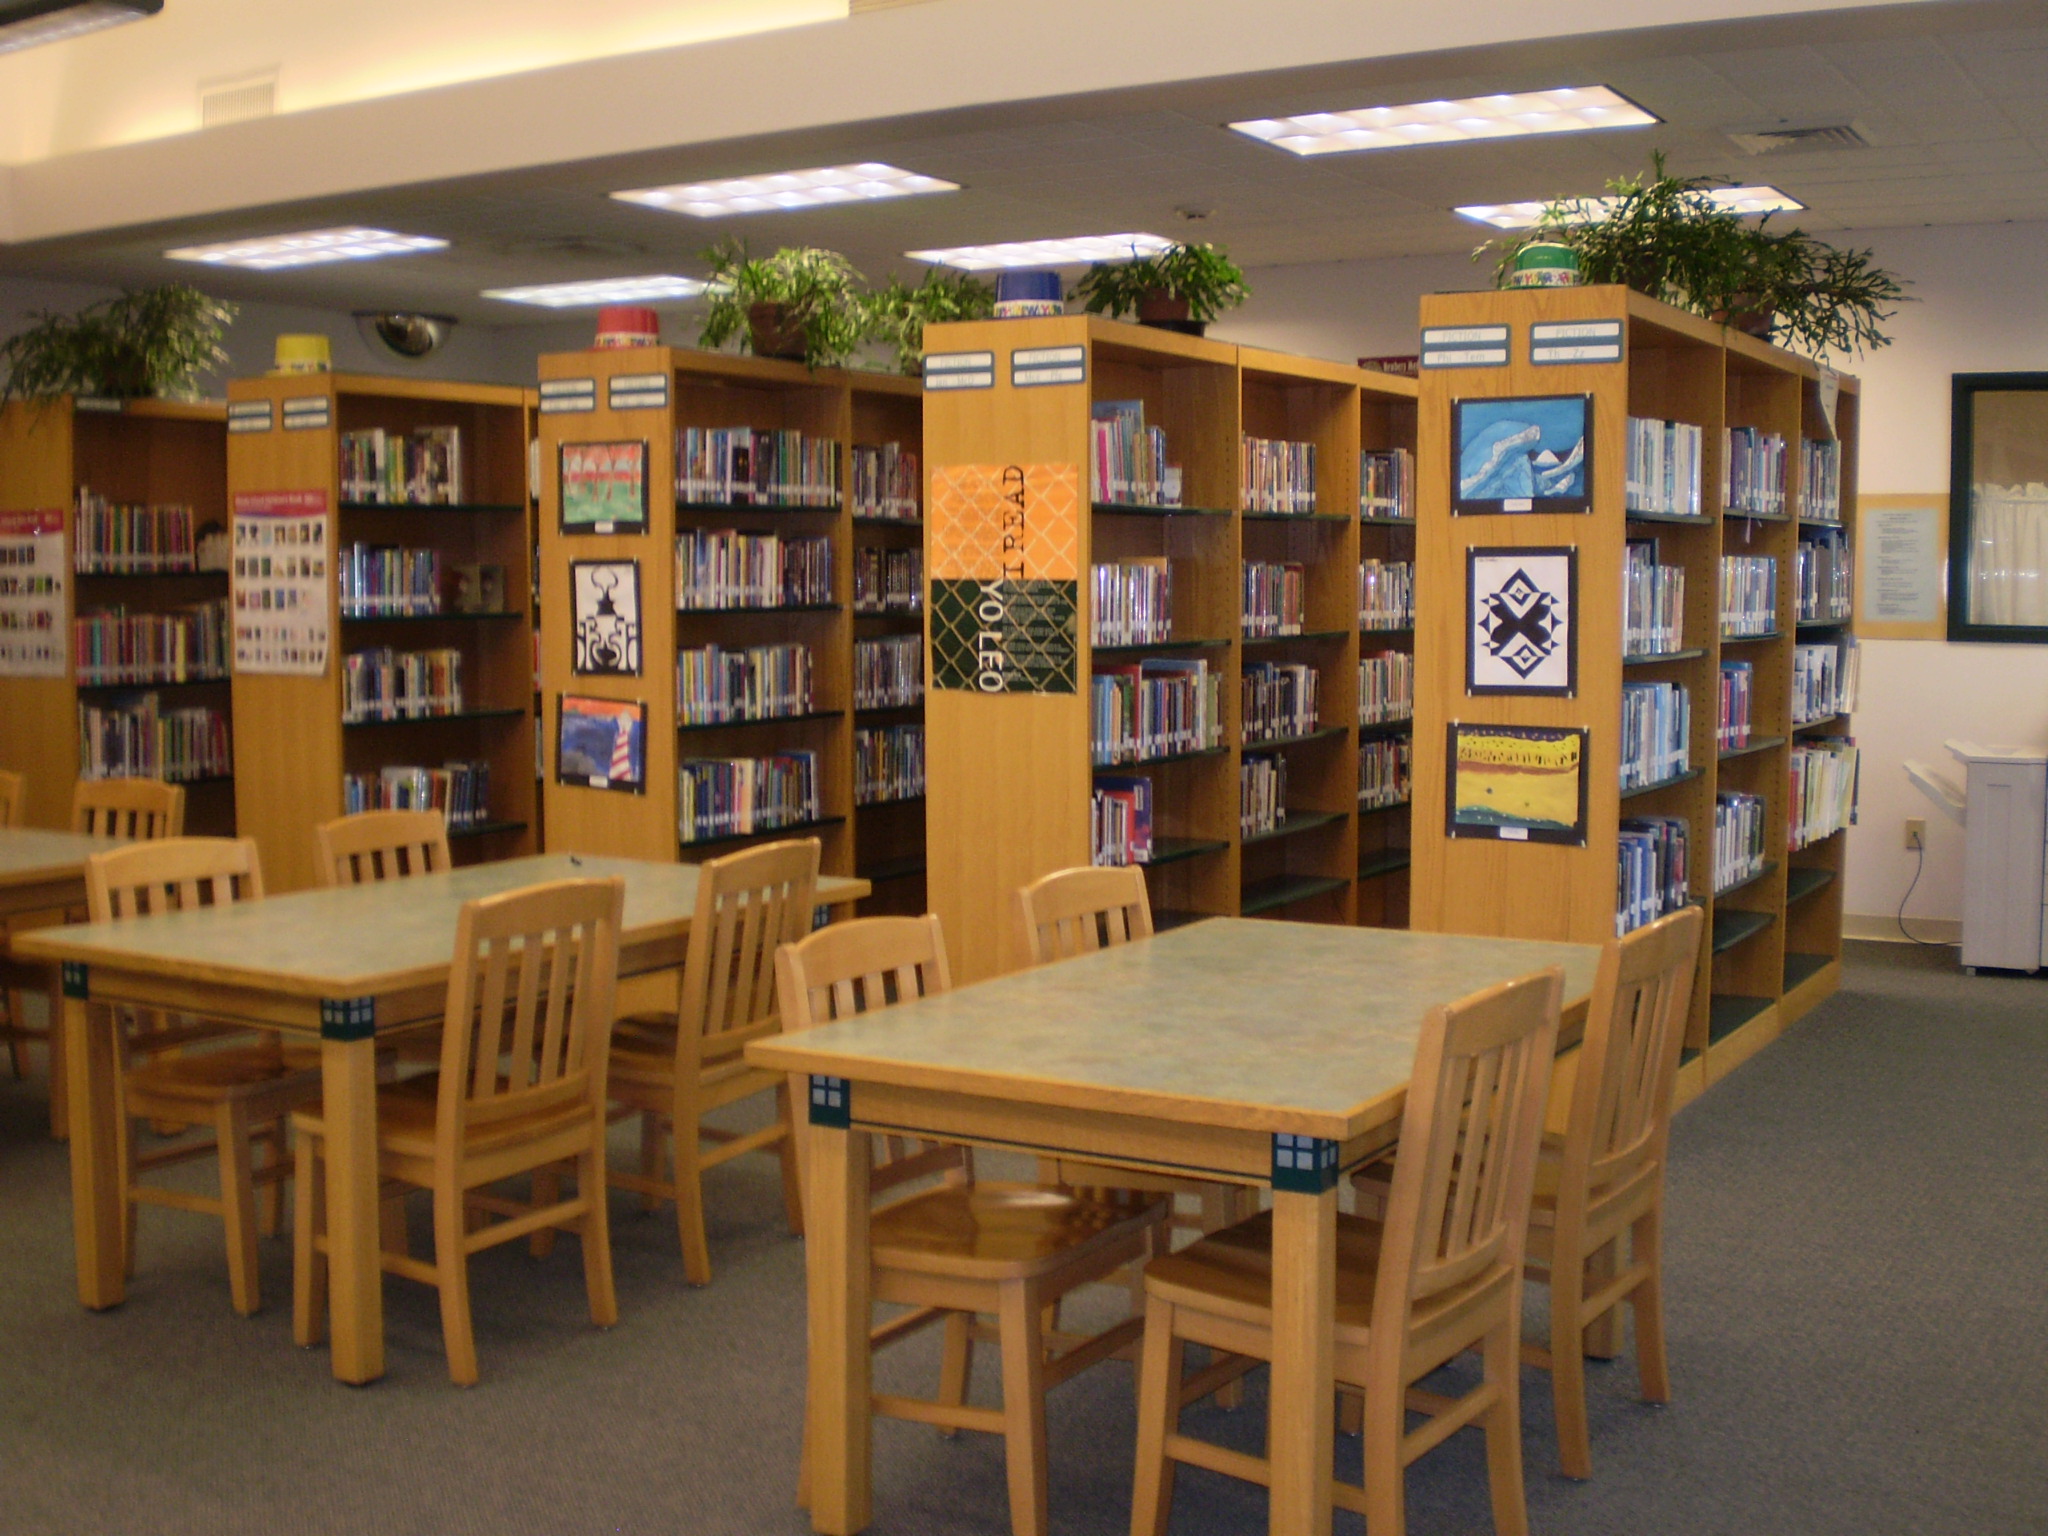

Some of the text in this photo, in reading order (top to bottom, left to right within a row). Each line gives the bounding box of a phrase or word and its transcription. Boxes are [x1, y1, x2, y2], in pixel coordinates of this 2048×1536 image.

[1443, 330, 1481, 342] FICTION
[1556, 326, 1596, 338] FICTION
[1003, 465, 1024, 579] I READ
[979, 578, 1003, 693] YO LEO
